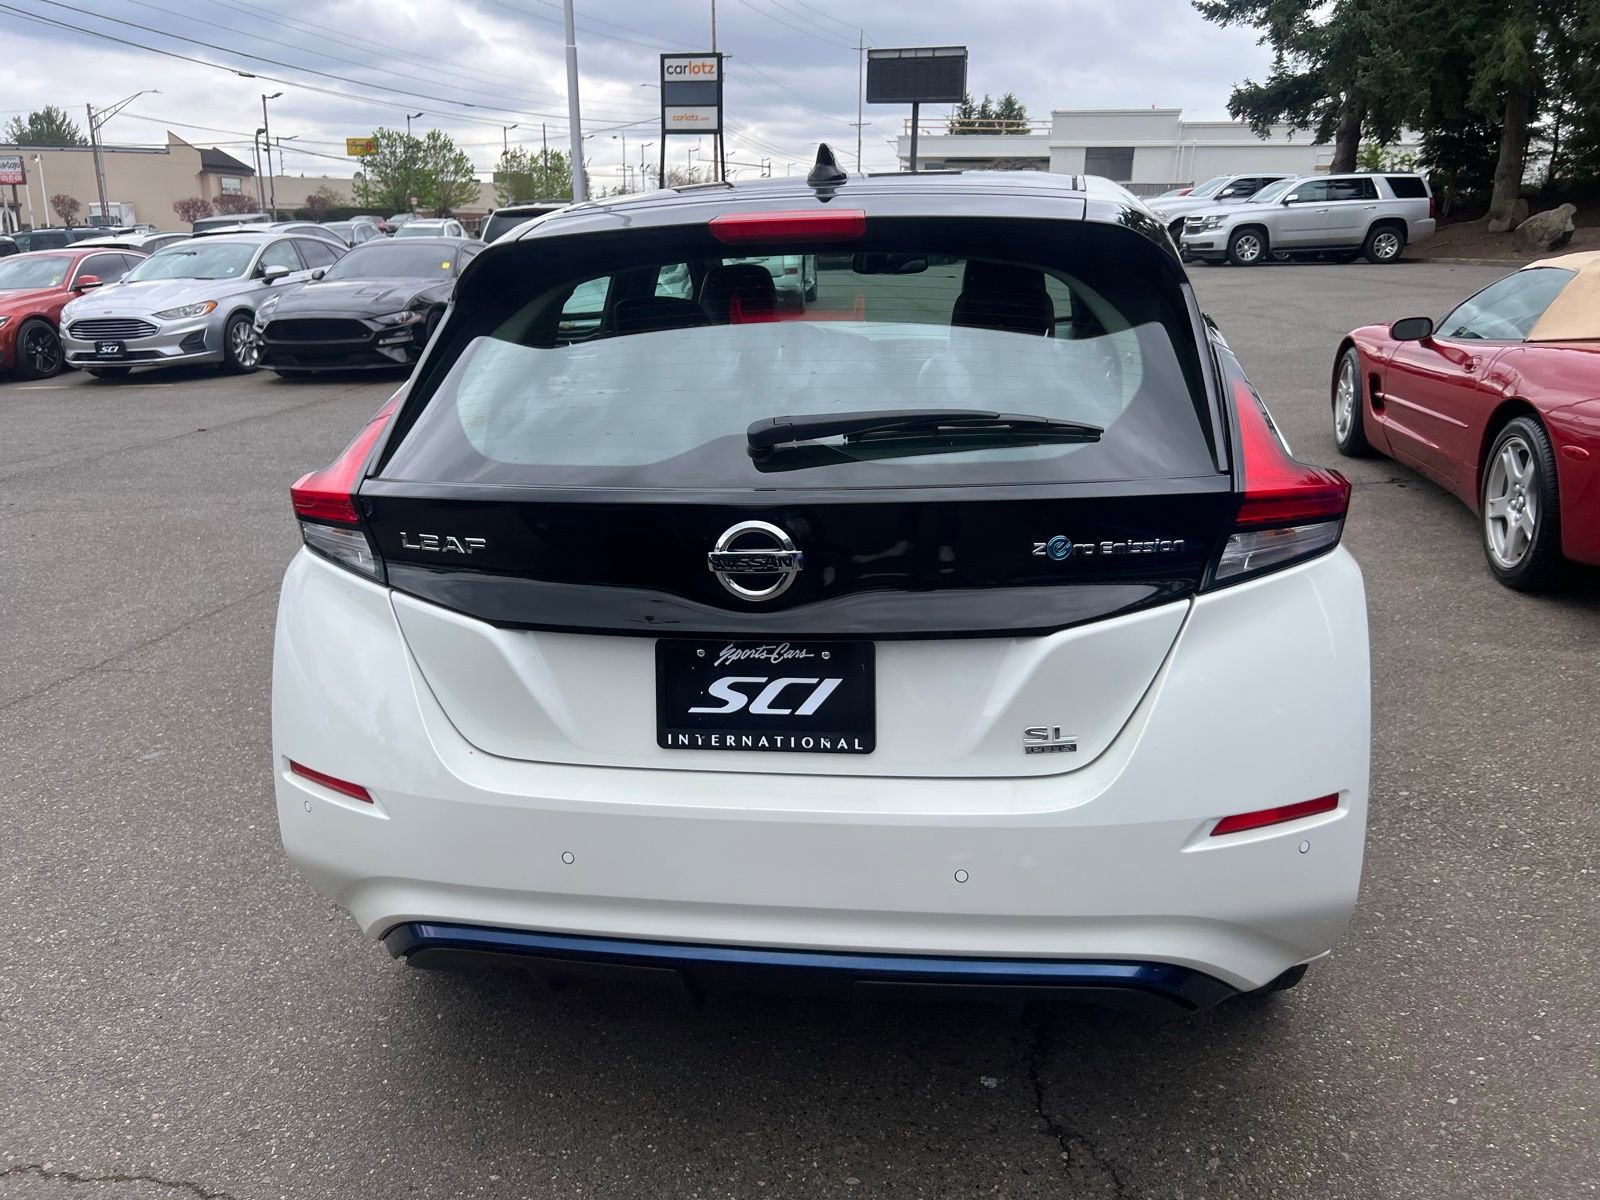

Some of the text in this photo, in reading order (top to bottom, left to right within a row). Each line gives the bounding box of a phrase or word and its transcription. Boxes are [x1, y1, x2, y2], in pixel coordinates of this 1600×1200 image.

[666, 60, 715, 75] carlotz
[400, 531, 486, 554] LEAF
[1099, 538, 1185, 554] Emission
[718, 557, 796, 570] NISSAN
[714, 642, 815, 666] Sports Cars
[687, 676, 843, 715] SCI
[667, 733, 864, 750] INTERNATIONAL
[1024, 725, 1079, 742] SL
